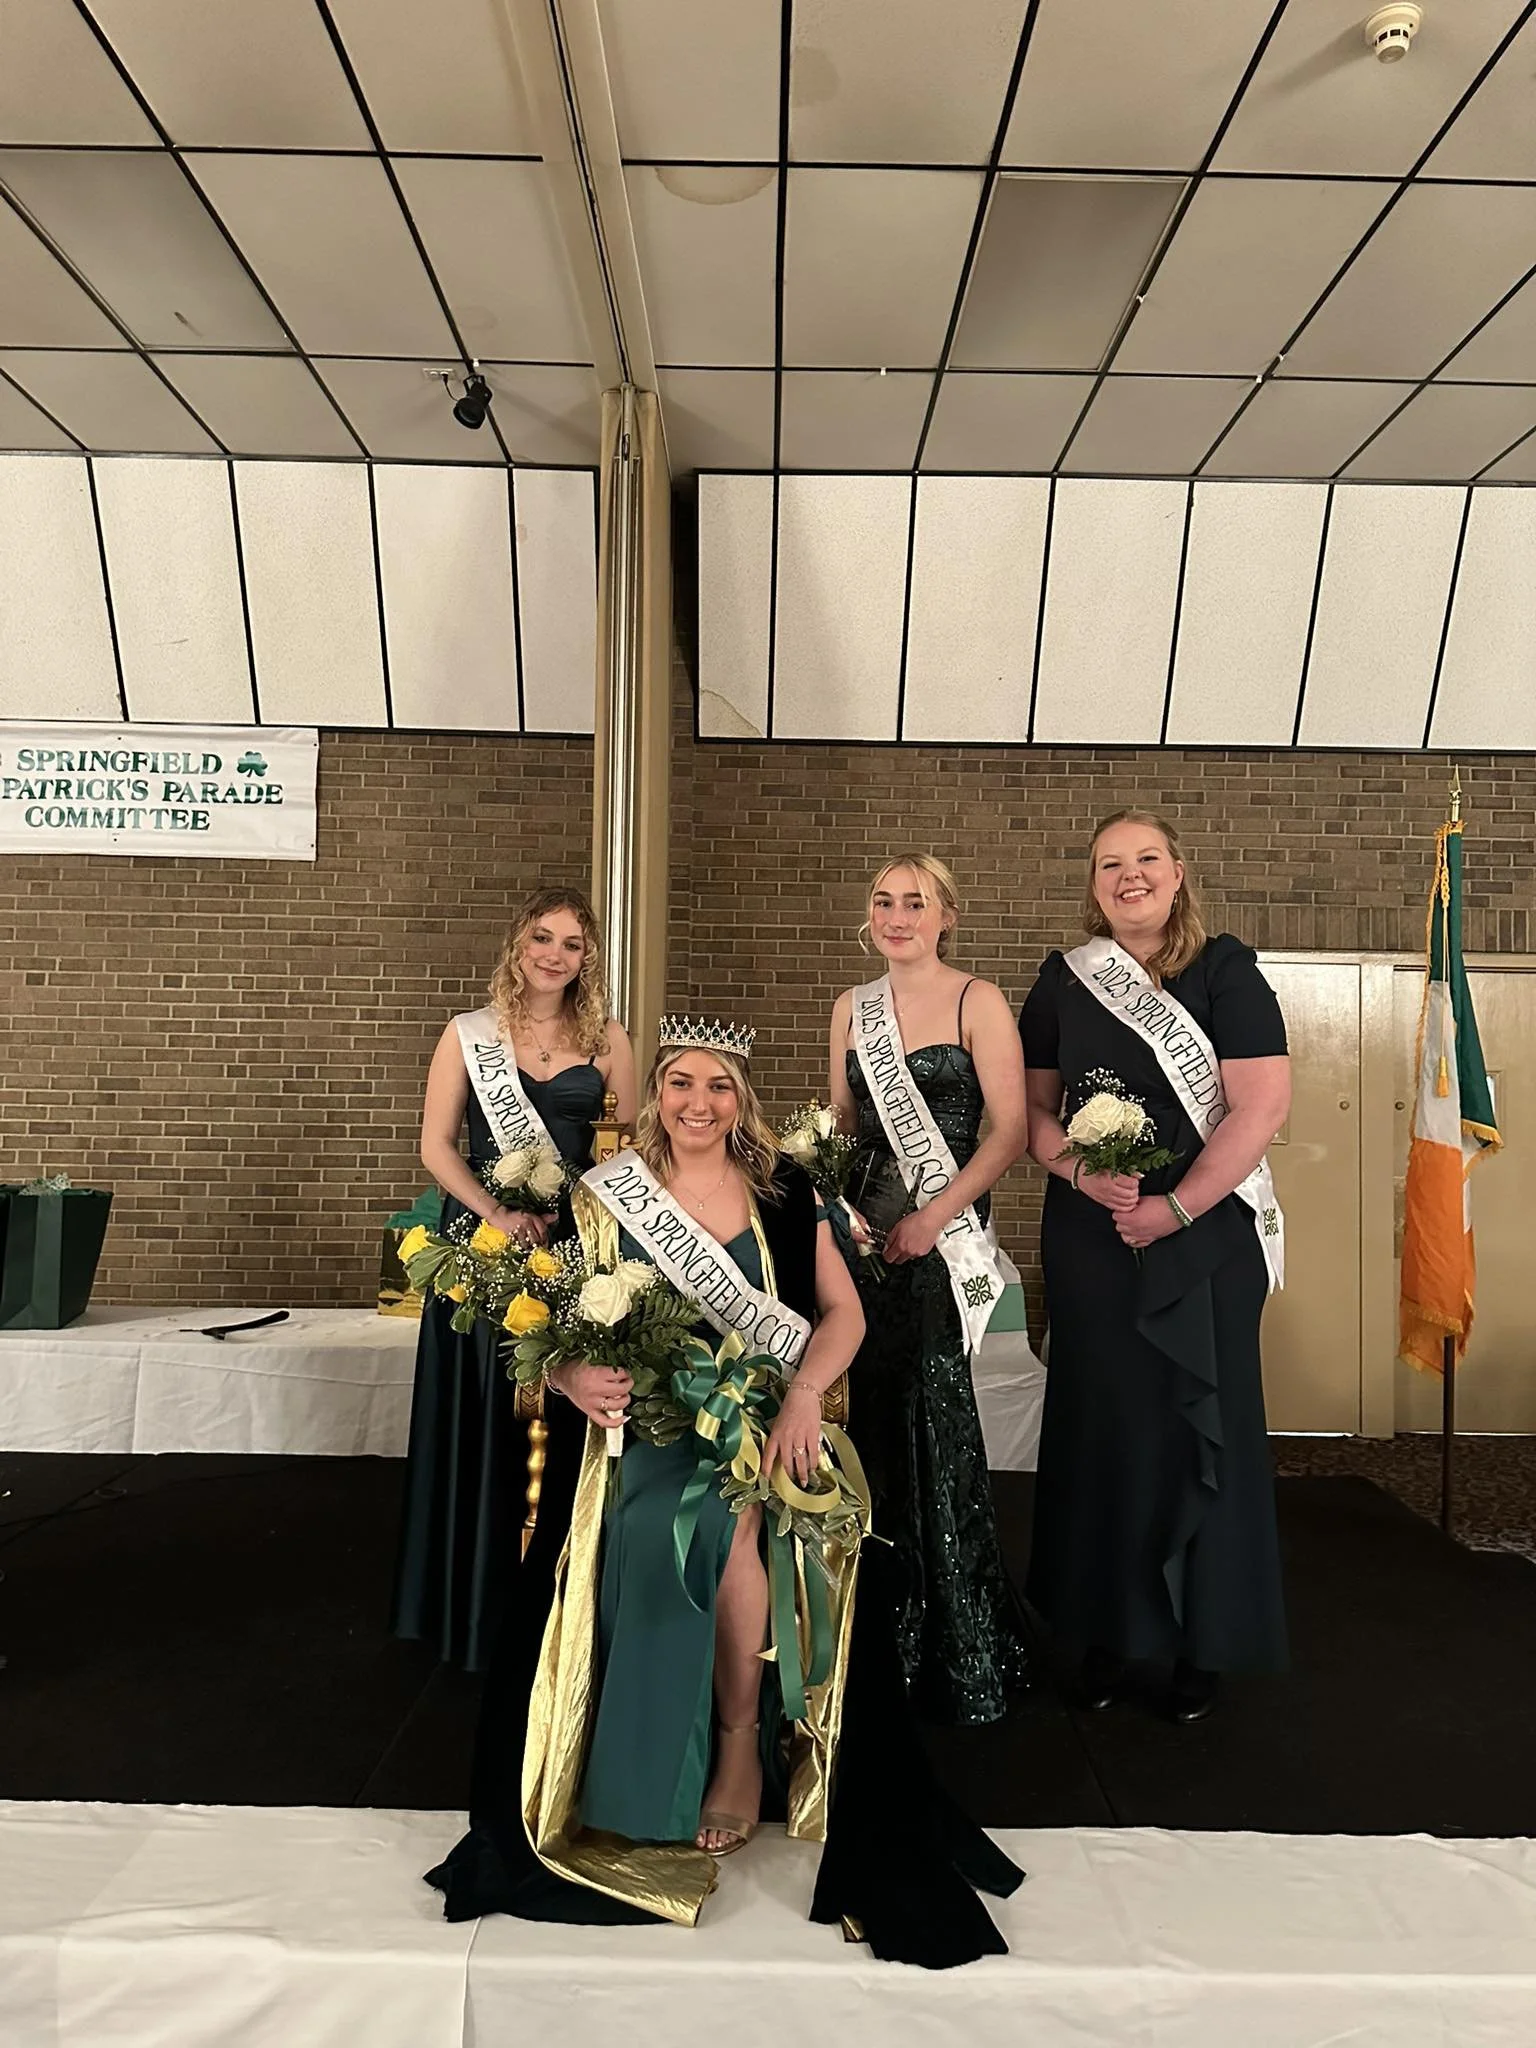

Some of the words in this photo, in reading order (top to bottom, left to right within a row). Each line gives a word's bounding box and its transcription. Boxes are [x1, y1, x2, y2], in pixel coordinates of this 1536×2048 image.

[17, 749, 222, 774] SPRINGFIELD
[2, 777, 149, 801] PATRICK'S
[162, 781, 284, 805] PARADE
[25, 805, 211, 831] COMMITTEE
[861, 993, 887, 1034] 2025
[1092, 957, 1140, 999] 2025
[1125, 991, 1219, 1106] SPRINGFIELD
[474, 1040, 508, 1083] 2025
[866, 1034, 932, 1158] SPRINGFIELD
[603, 1165, 658, 1215] 2025
[642, 1209, 758, 1331] SPRINGFIELD
